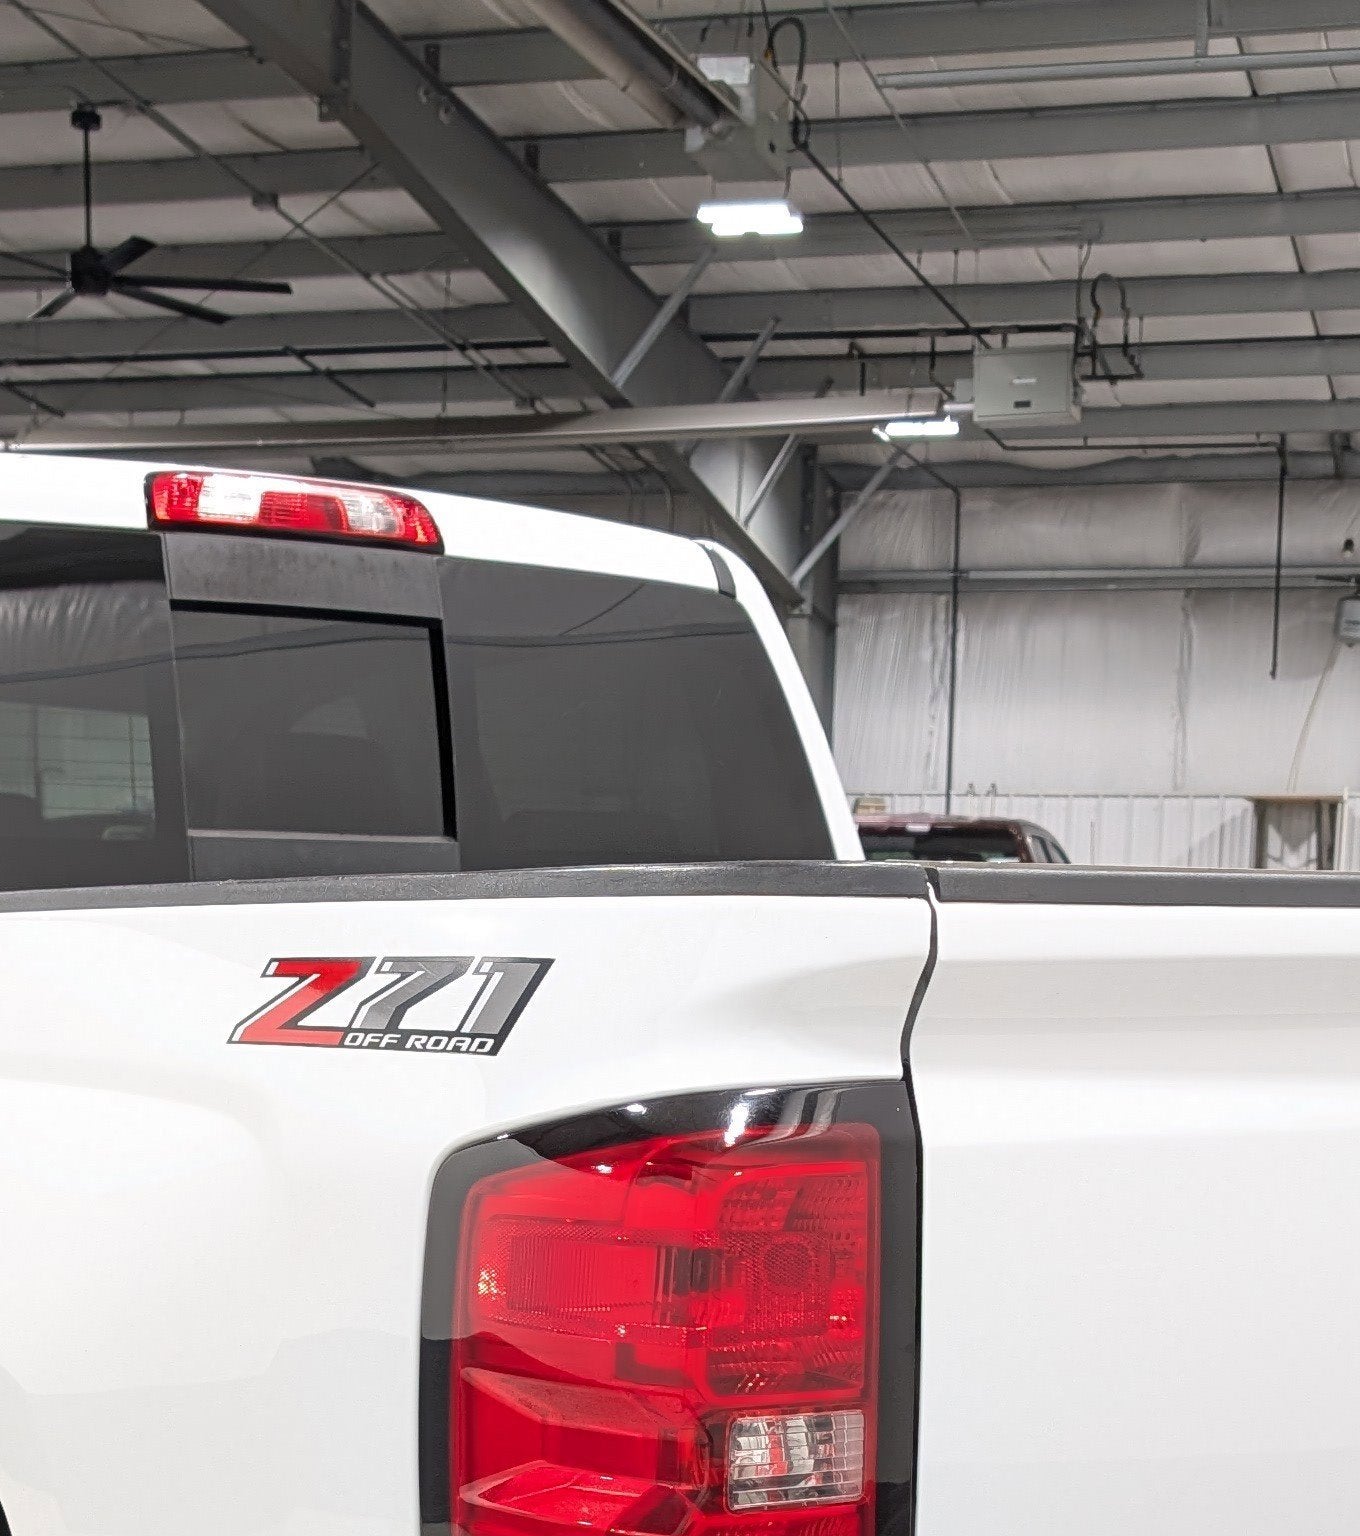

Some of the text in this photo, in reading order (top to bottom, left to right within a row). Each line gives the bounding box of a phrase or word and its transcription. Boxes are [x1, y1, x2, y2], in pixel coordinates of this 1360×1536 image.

[227, 956, 556, 1048] Z71
[343, 1032, 495, 1053] OFF ROAD
